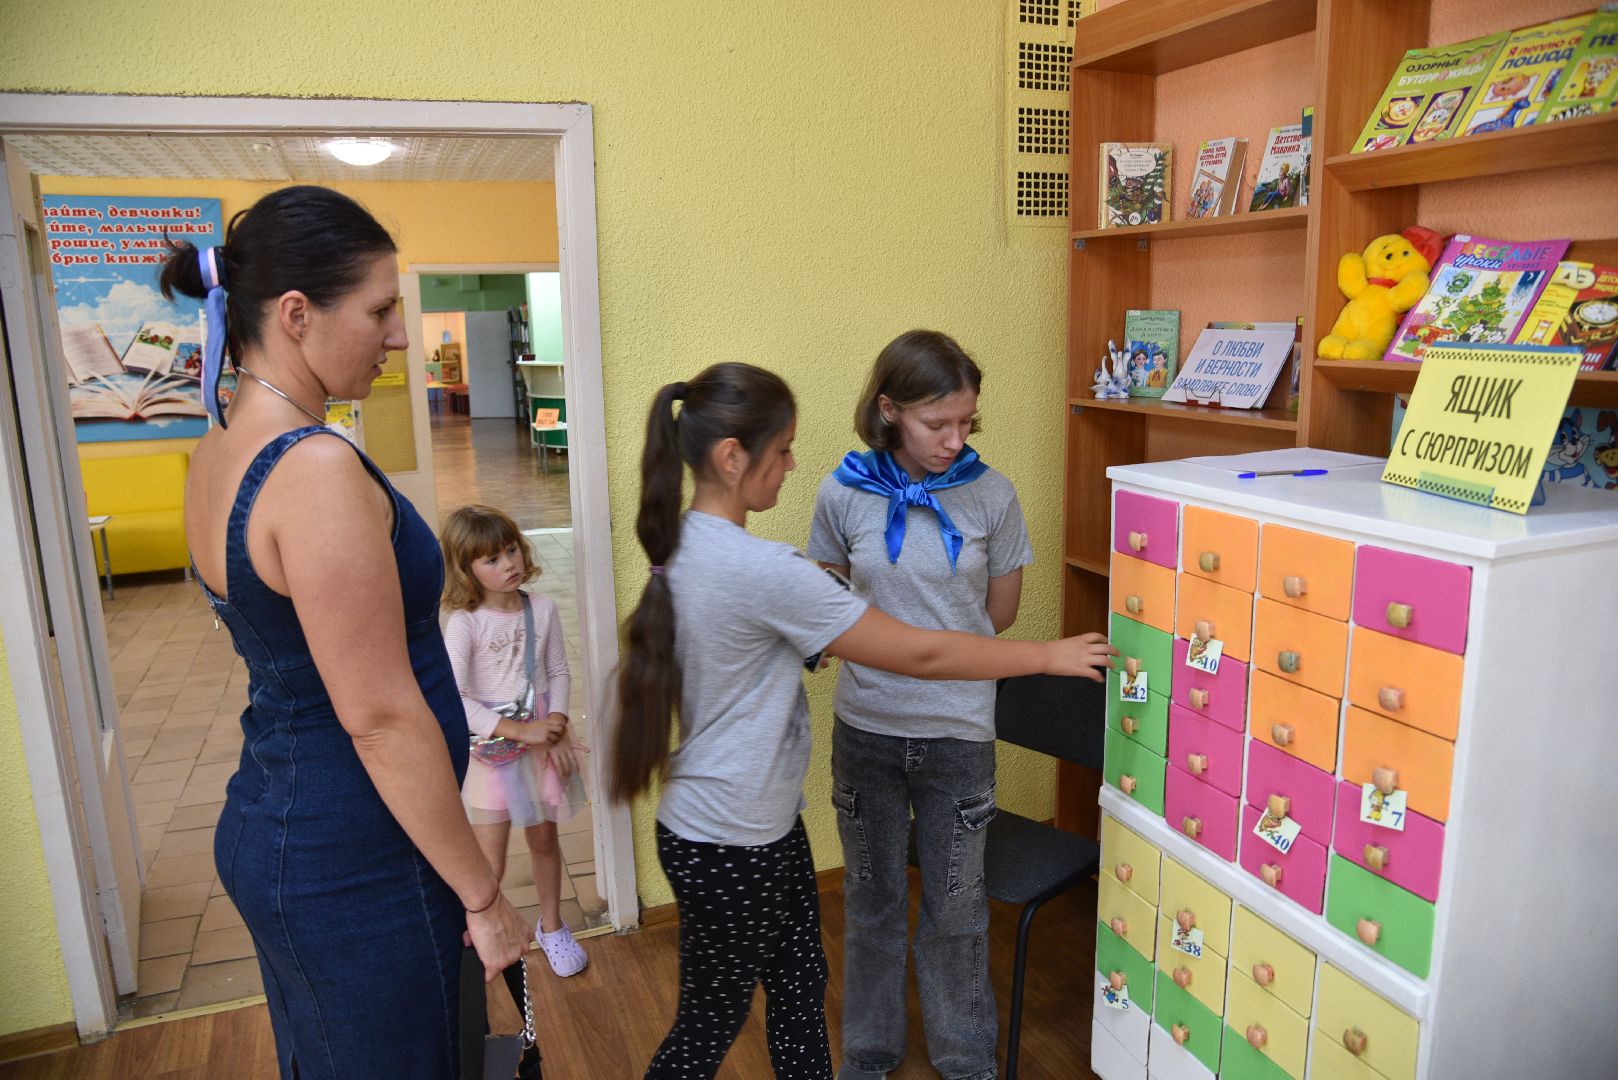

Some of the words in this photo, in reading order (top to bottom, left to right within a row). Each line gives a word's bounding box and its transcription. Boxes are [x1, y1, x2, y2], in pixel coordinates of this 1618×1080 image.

[1405, 57, 1463, 73] ОЗОРНЫЕ
[109, 206, 200, 218] девчонки!
[100, 222, 212, 233] мальчишки!
[105, 253, 169, 264] книжк
[1212, 340, 1223, 355] О
[1221, 341, 1264, 358] ЛЮБВИ
[1194, 359, 1207, 374] И
[1204, 359, 1263, 379] ВЕРНОСТИ
[1173, 378, 1230, 394] ЗАМОЛВИТЕ
[1226, 382, 1261, 397] СЛОВО
[1443, 374, 1523, 423] ЯЩИК
[1401, 428, 1415, 456] С
[1415, 431, 1534, 479] СЮРПРИЗОМ
[1391, 811, 1402, 827] 7
[1184, 942, 1201, 957] 38
[1121, 999, 1129, 1009] 5
